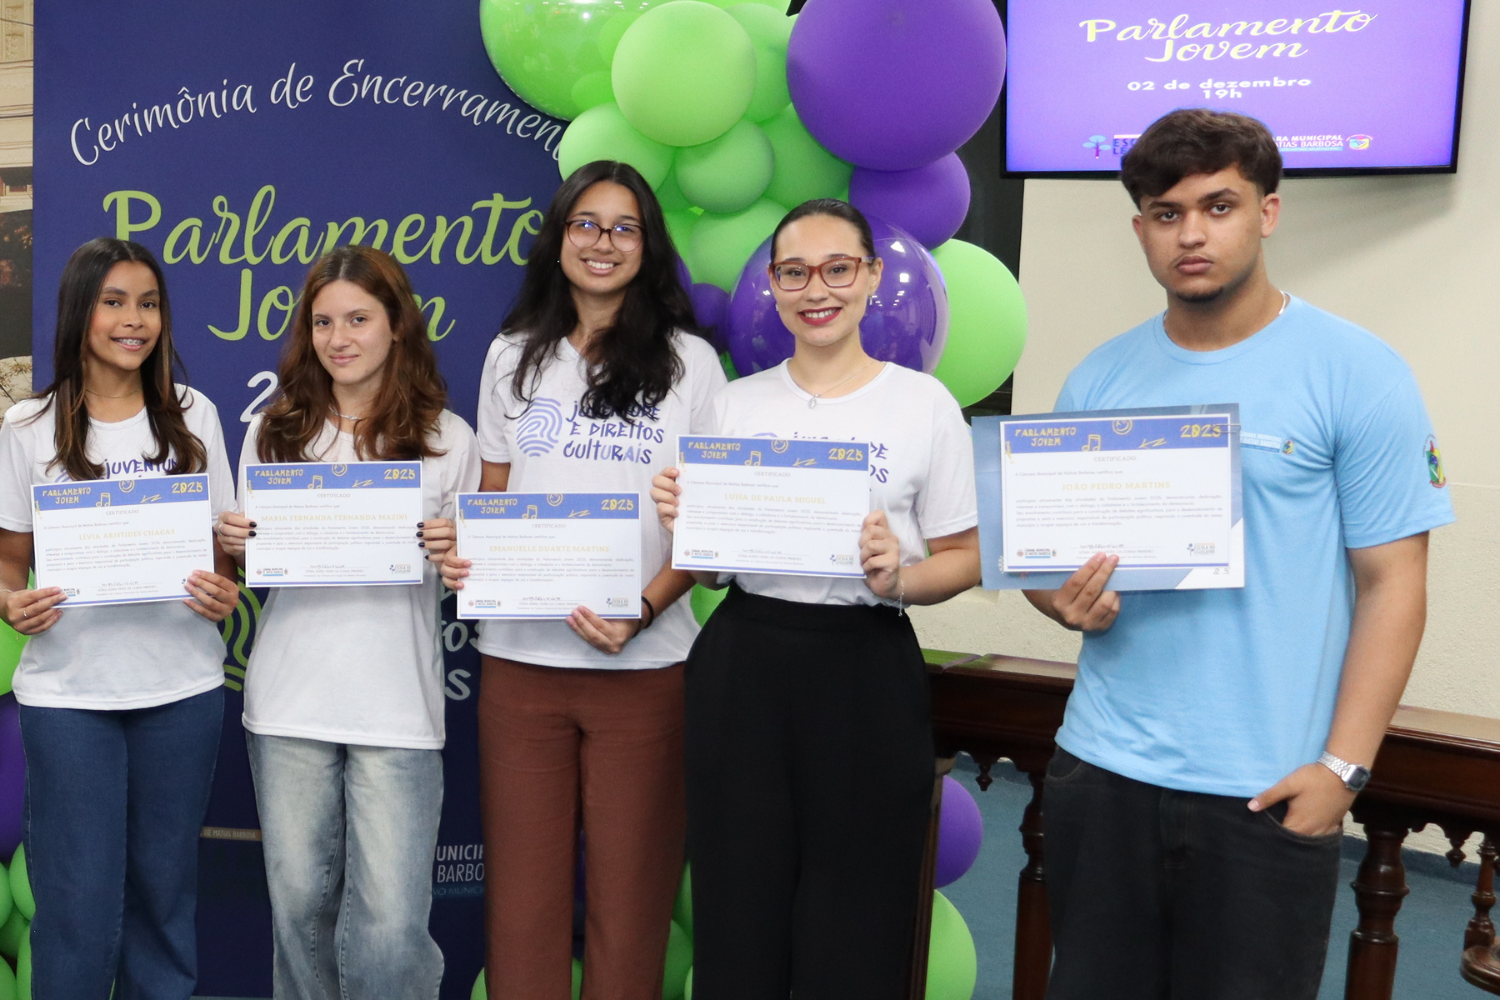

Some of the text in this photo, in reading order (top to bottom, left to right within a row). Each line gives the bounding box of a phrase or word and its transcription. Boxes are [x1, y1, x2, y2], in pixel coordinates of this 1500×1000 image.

[1079, 9, 1378, 42] Parlamento
[1144, 37, 1308, 62] Jovem
[1127, 75, 1312, 91] 02 de dezembro
[1202, 88, 1242, 99] 19h
[70, 58, 569, 166] Cerimônia de Encerramen
[103, 184, 546, 266] Parlamento
[1015, 425, 1077, 437] PARLAMENTO
[1180, 423, 1222, 438] 2025
[1030, 437, 1062, 447] JOVEM
[688, 441, 864, 461] PARLAMENTO 2025
[701, 450, 728, 460] JOVEM
[1093, 455, 1137, 463] CERTIFICADO
[254, 468, 416, 480] PARLAMENTO 2025
[267, 477, 292, 485] JOVEM
[1062, 480, 1171, 492] JOÃO PEDRO MARTINS
[42, 481, 204, 497] PARLAMENTO 2025
[55, 496, 80, 505] JOVEM
[467, 498, 634, 511] PARLAMENTO 2025
[750, 494, 761, 502] DE
[763, 494, 792, 503] PAULA
[794, 496, 827, 504] MIGUEL
[103, 530, 142, 539] ARISTIDES
[143, 528, 175, 537] CHAGAS
[436, 844, 483, 861] UNICI
[437, 862, 485, 883] BARBO
